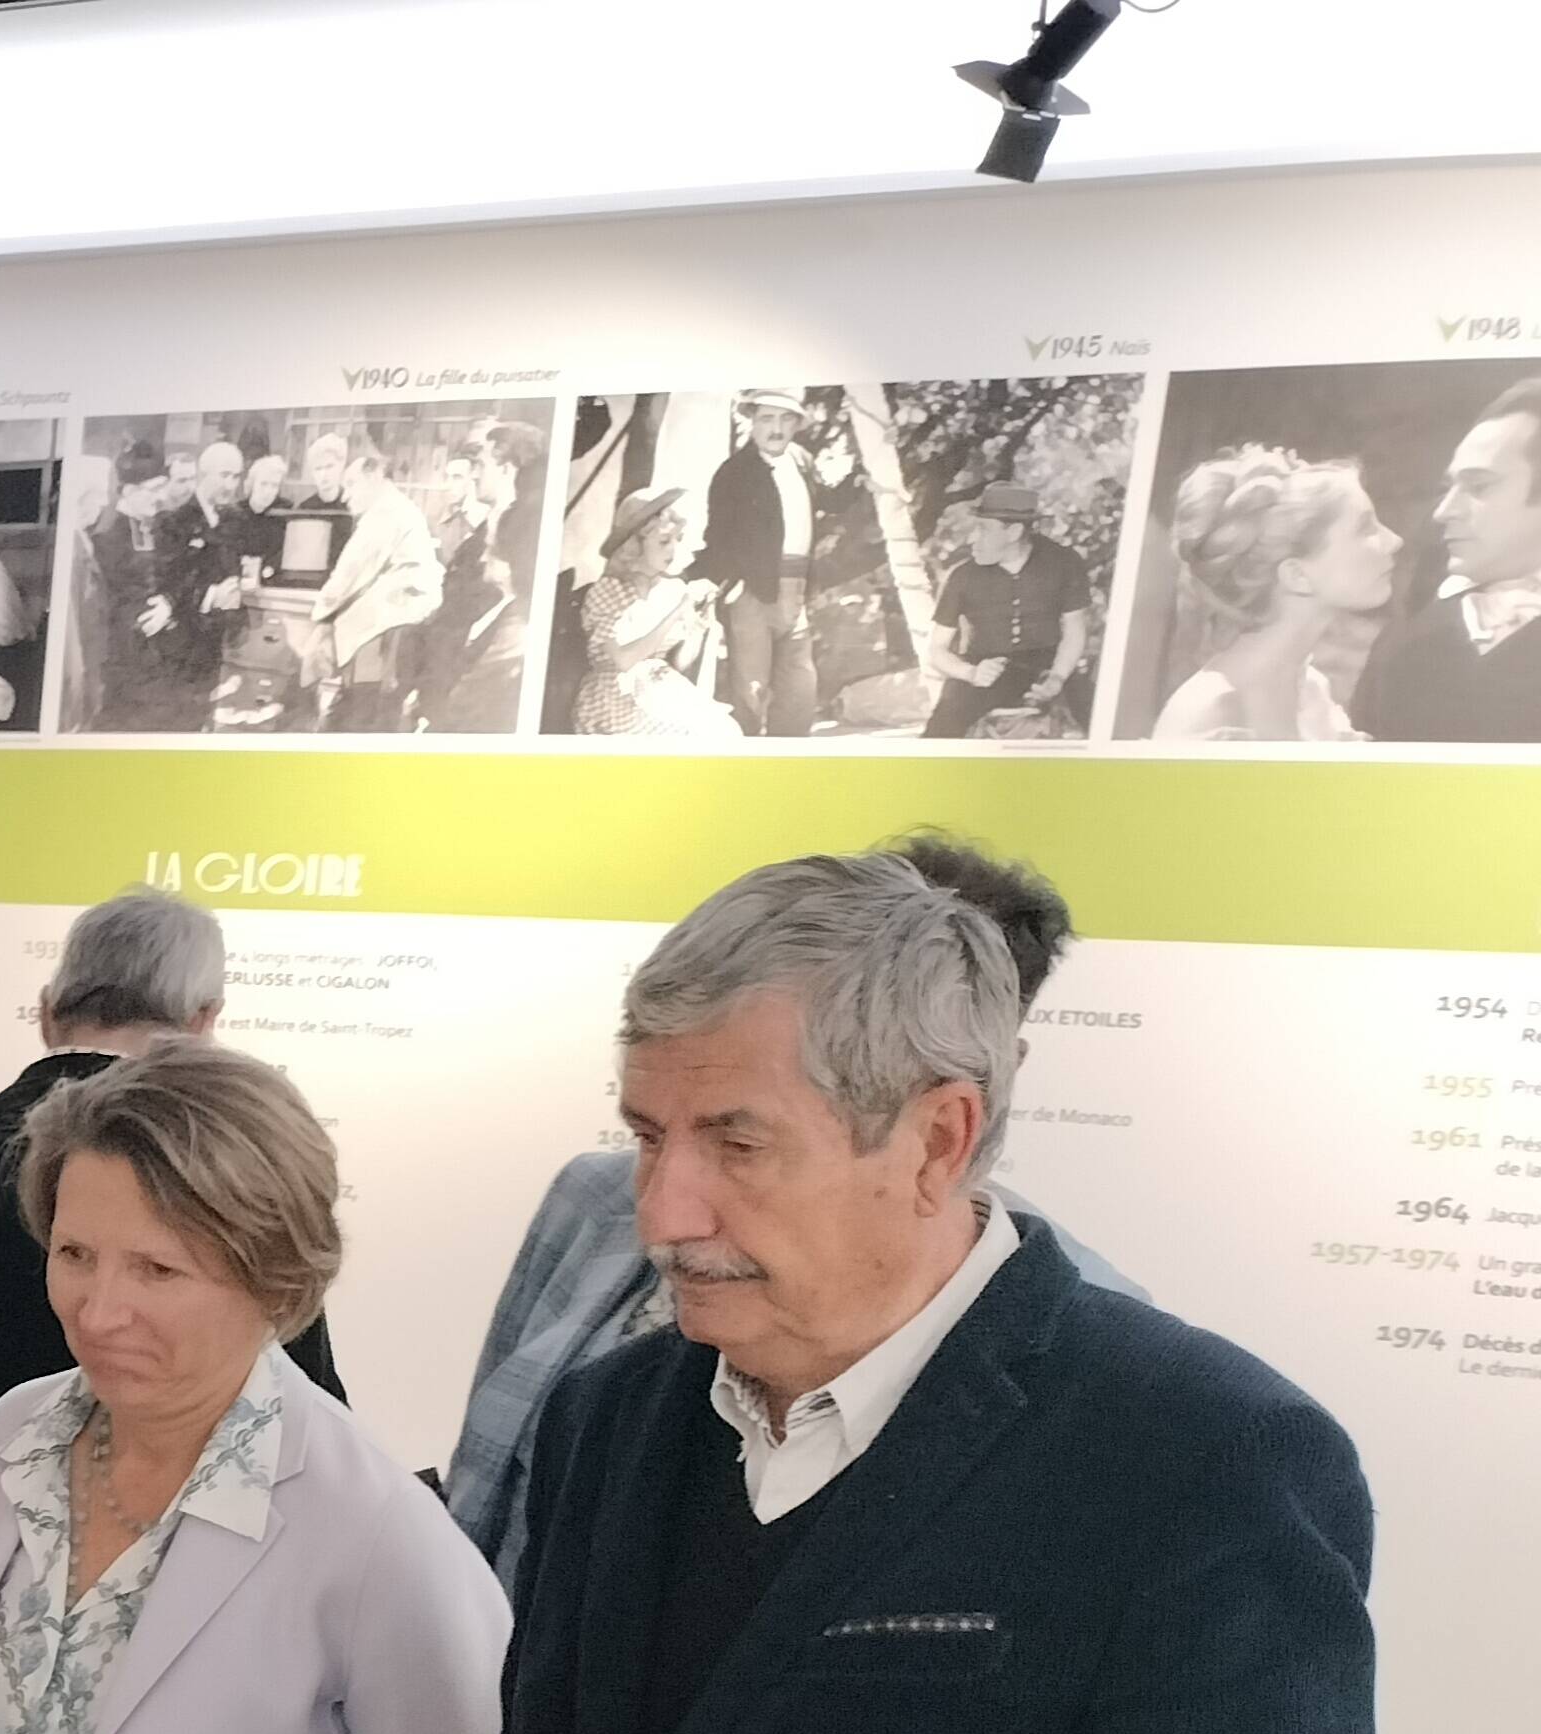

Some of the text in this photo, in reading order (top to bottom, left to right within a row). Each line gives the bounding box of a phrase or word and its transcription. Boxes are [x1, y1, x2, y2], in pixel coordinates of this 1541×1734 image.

[1467, 317, 1523, 342] 1948
[1050, 334, 1104, 360] 1945
[362, 366, 410, 390] 1940
[145, 850, 364, 898] LA GLOIRE
[223, 971, 294, 987] ERLUSSE
[316, 975, 391, 990] CIGALON
[1025, 1009, 1143, 1029] UX ETOILES
[1436, 996, 1509, 1020] 1954
[1423, 1073, 1495, 1099] 1955
[1058, 1107, 1134, 1128] Monaco
[1410, 1126, 1484, 1152] 1961
[1494, 1160, 1522, 1177] de
[1395, 1196, 1471, 1226] 1964
[1309, 1241, 1461, 1273] 1957-1974
[1477, 1254, 1507, 1271] Un
[1472, 1279, 1527, 1299] L'eau
[1374, 1325, 1447, 1352] 1974
[1462, 1332, 1526, 1355] Décès
[1457, 1357, 1483, 1375] Le
